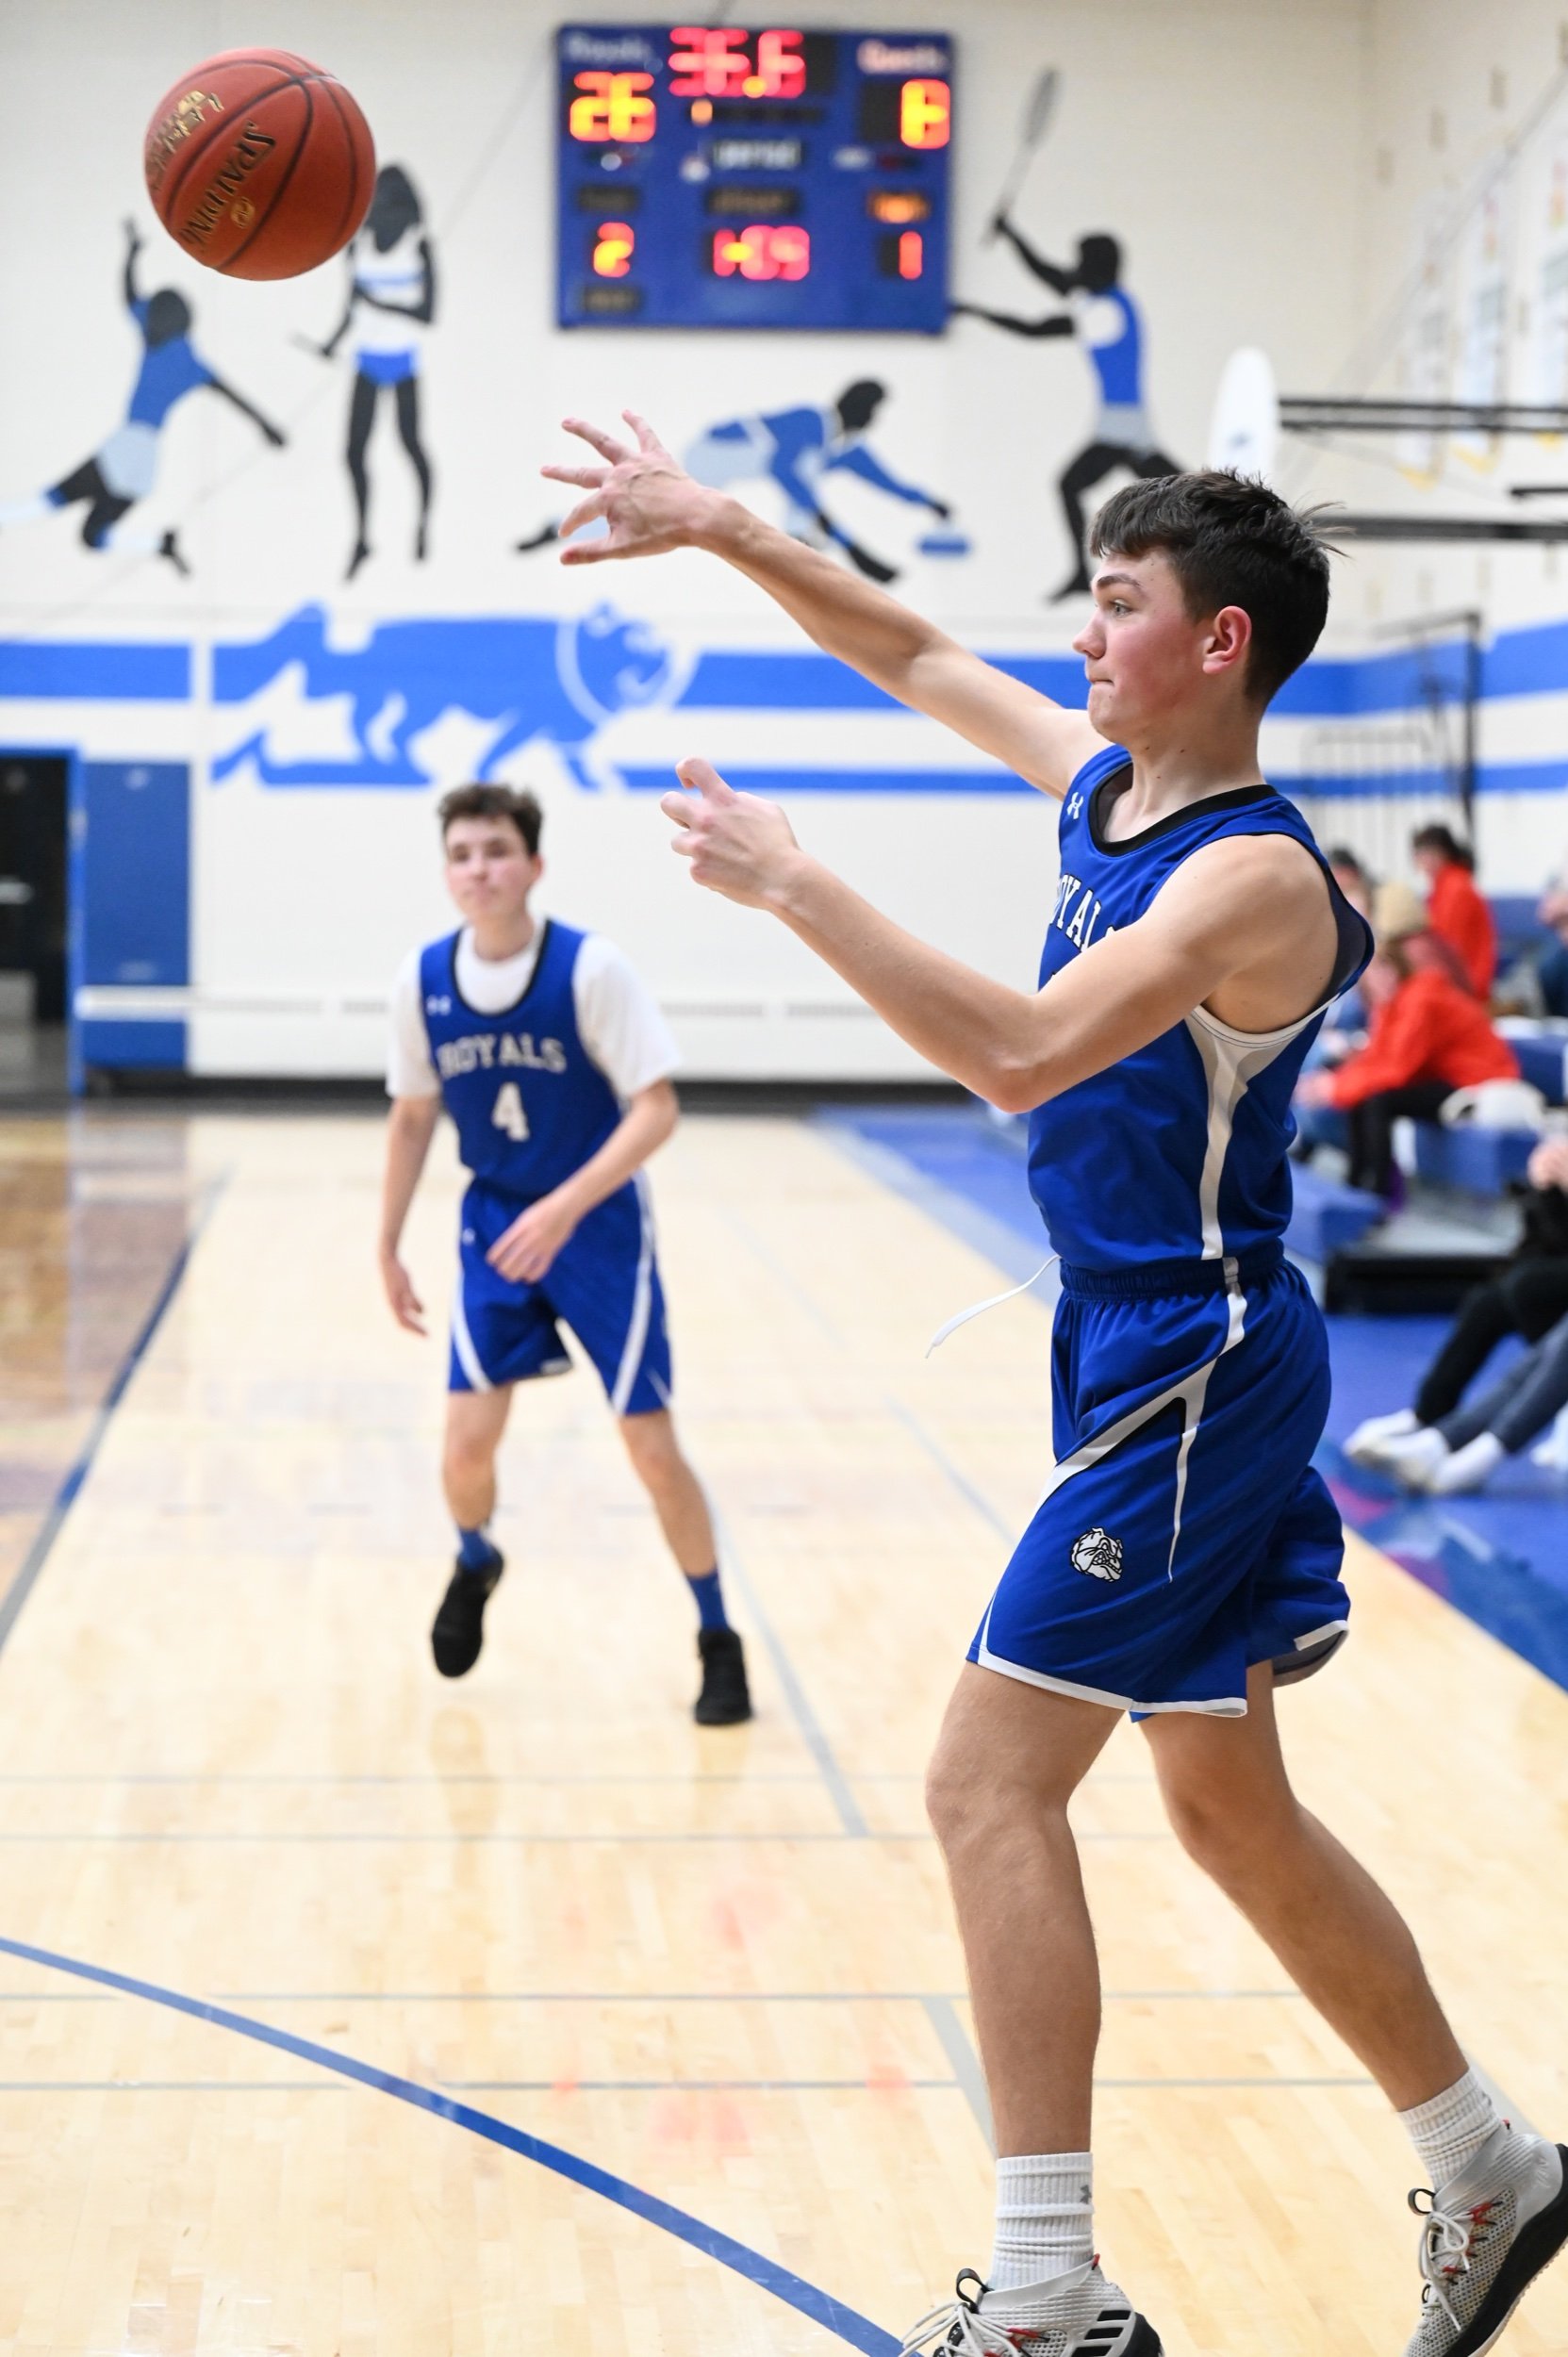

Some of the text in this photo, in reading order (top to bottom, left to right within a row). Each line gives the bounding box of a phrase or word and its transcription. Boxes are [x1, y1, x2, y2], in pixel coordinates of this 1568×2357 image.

[178, 119, 276, 254] SPALDING
[593, 222, 635, 278] 2
[437, 1032, 568, 1080] ROYALS
[491, 1081, 531, 1142] 4
